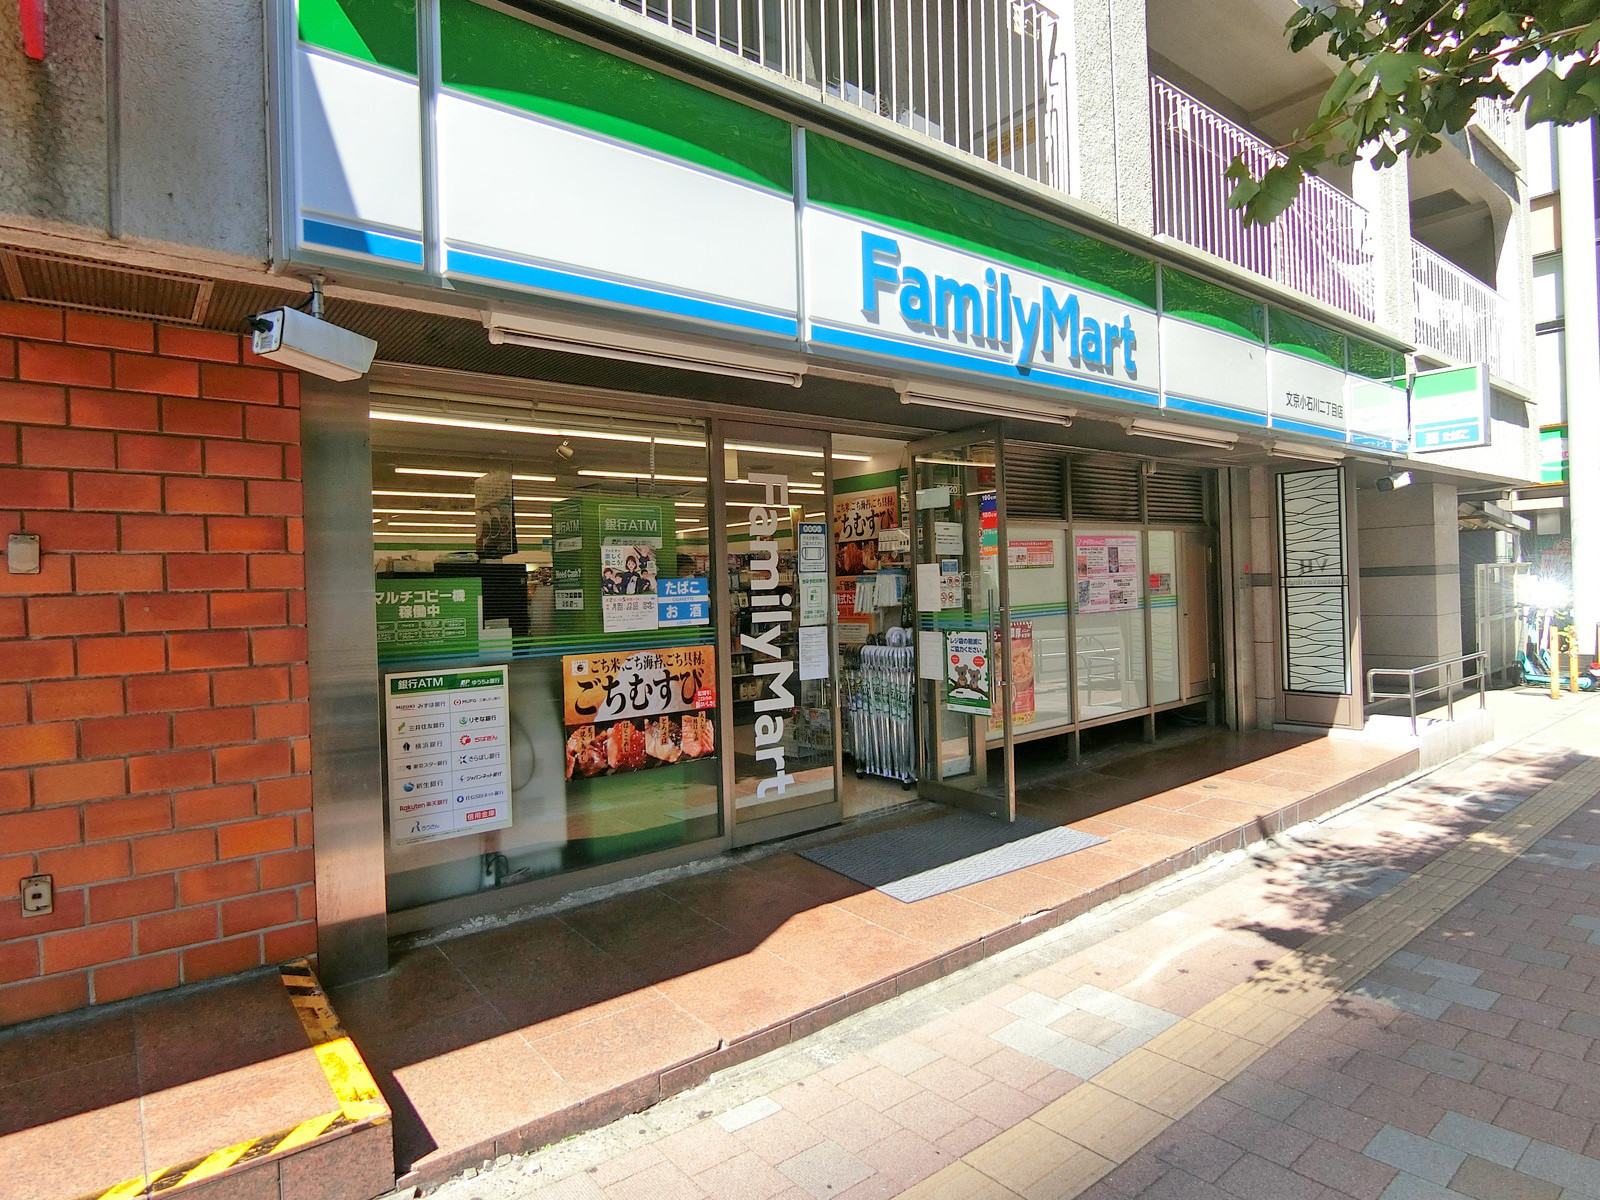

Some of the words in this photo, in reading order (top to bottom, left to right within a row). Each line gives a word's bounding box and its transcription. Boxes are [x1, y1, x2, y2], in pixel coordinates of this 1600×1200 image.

[861, 231, 1137, 374] FamilyMart
[1286, 390, 1343, 418] 文京小石川二丁目店
[605, 518, 657, 531] 銀行ATM
[665, 581, 700, 595] たばこ
[375, 589, 465, 604] マルチコピー機
[399, 604, 440, 618] 稼働中
[666, 604, 678, 618] お
[689, 603, 702, 617] 酒
[740, 473, 795, 799] FamilyMart
[591, 651, 705, 674] ごち米、ごち海苔、ごち具材。
[398, 677, 444, 690] 銀行ATM
[575, 668, 704, 715] ごちむすび
[469, 715, 496, 723] りそな銀行
[409, 722, 444, 731] 三井住友銀行
[415, 740, 443, 749] 横浜銀行
[469, 752, 500, 762] きらぼし銀行
[413, 760, 447, 769] 東京スター銀行
[416, 779, 443, 789] 新生銀行
[400, 803, 425, 812] Rakuten
[426, 799, 448, 807] 楽天銀行
[467, 809, 495, 821] 信用金庫
